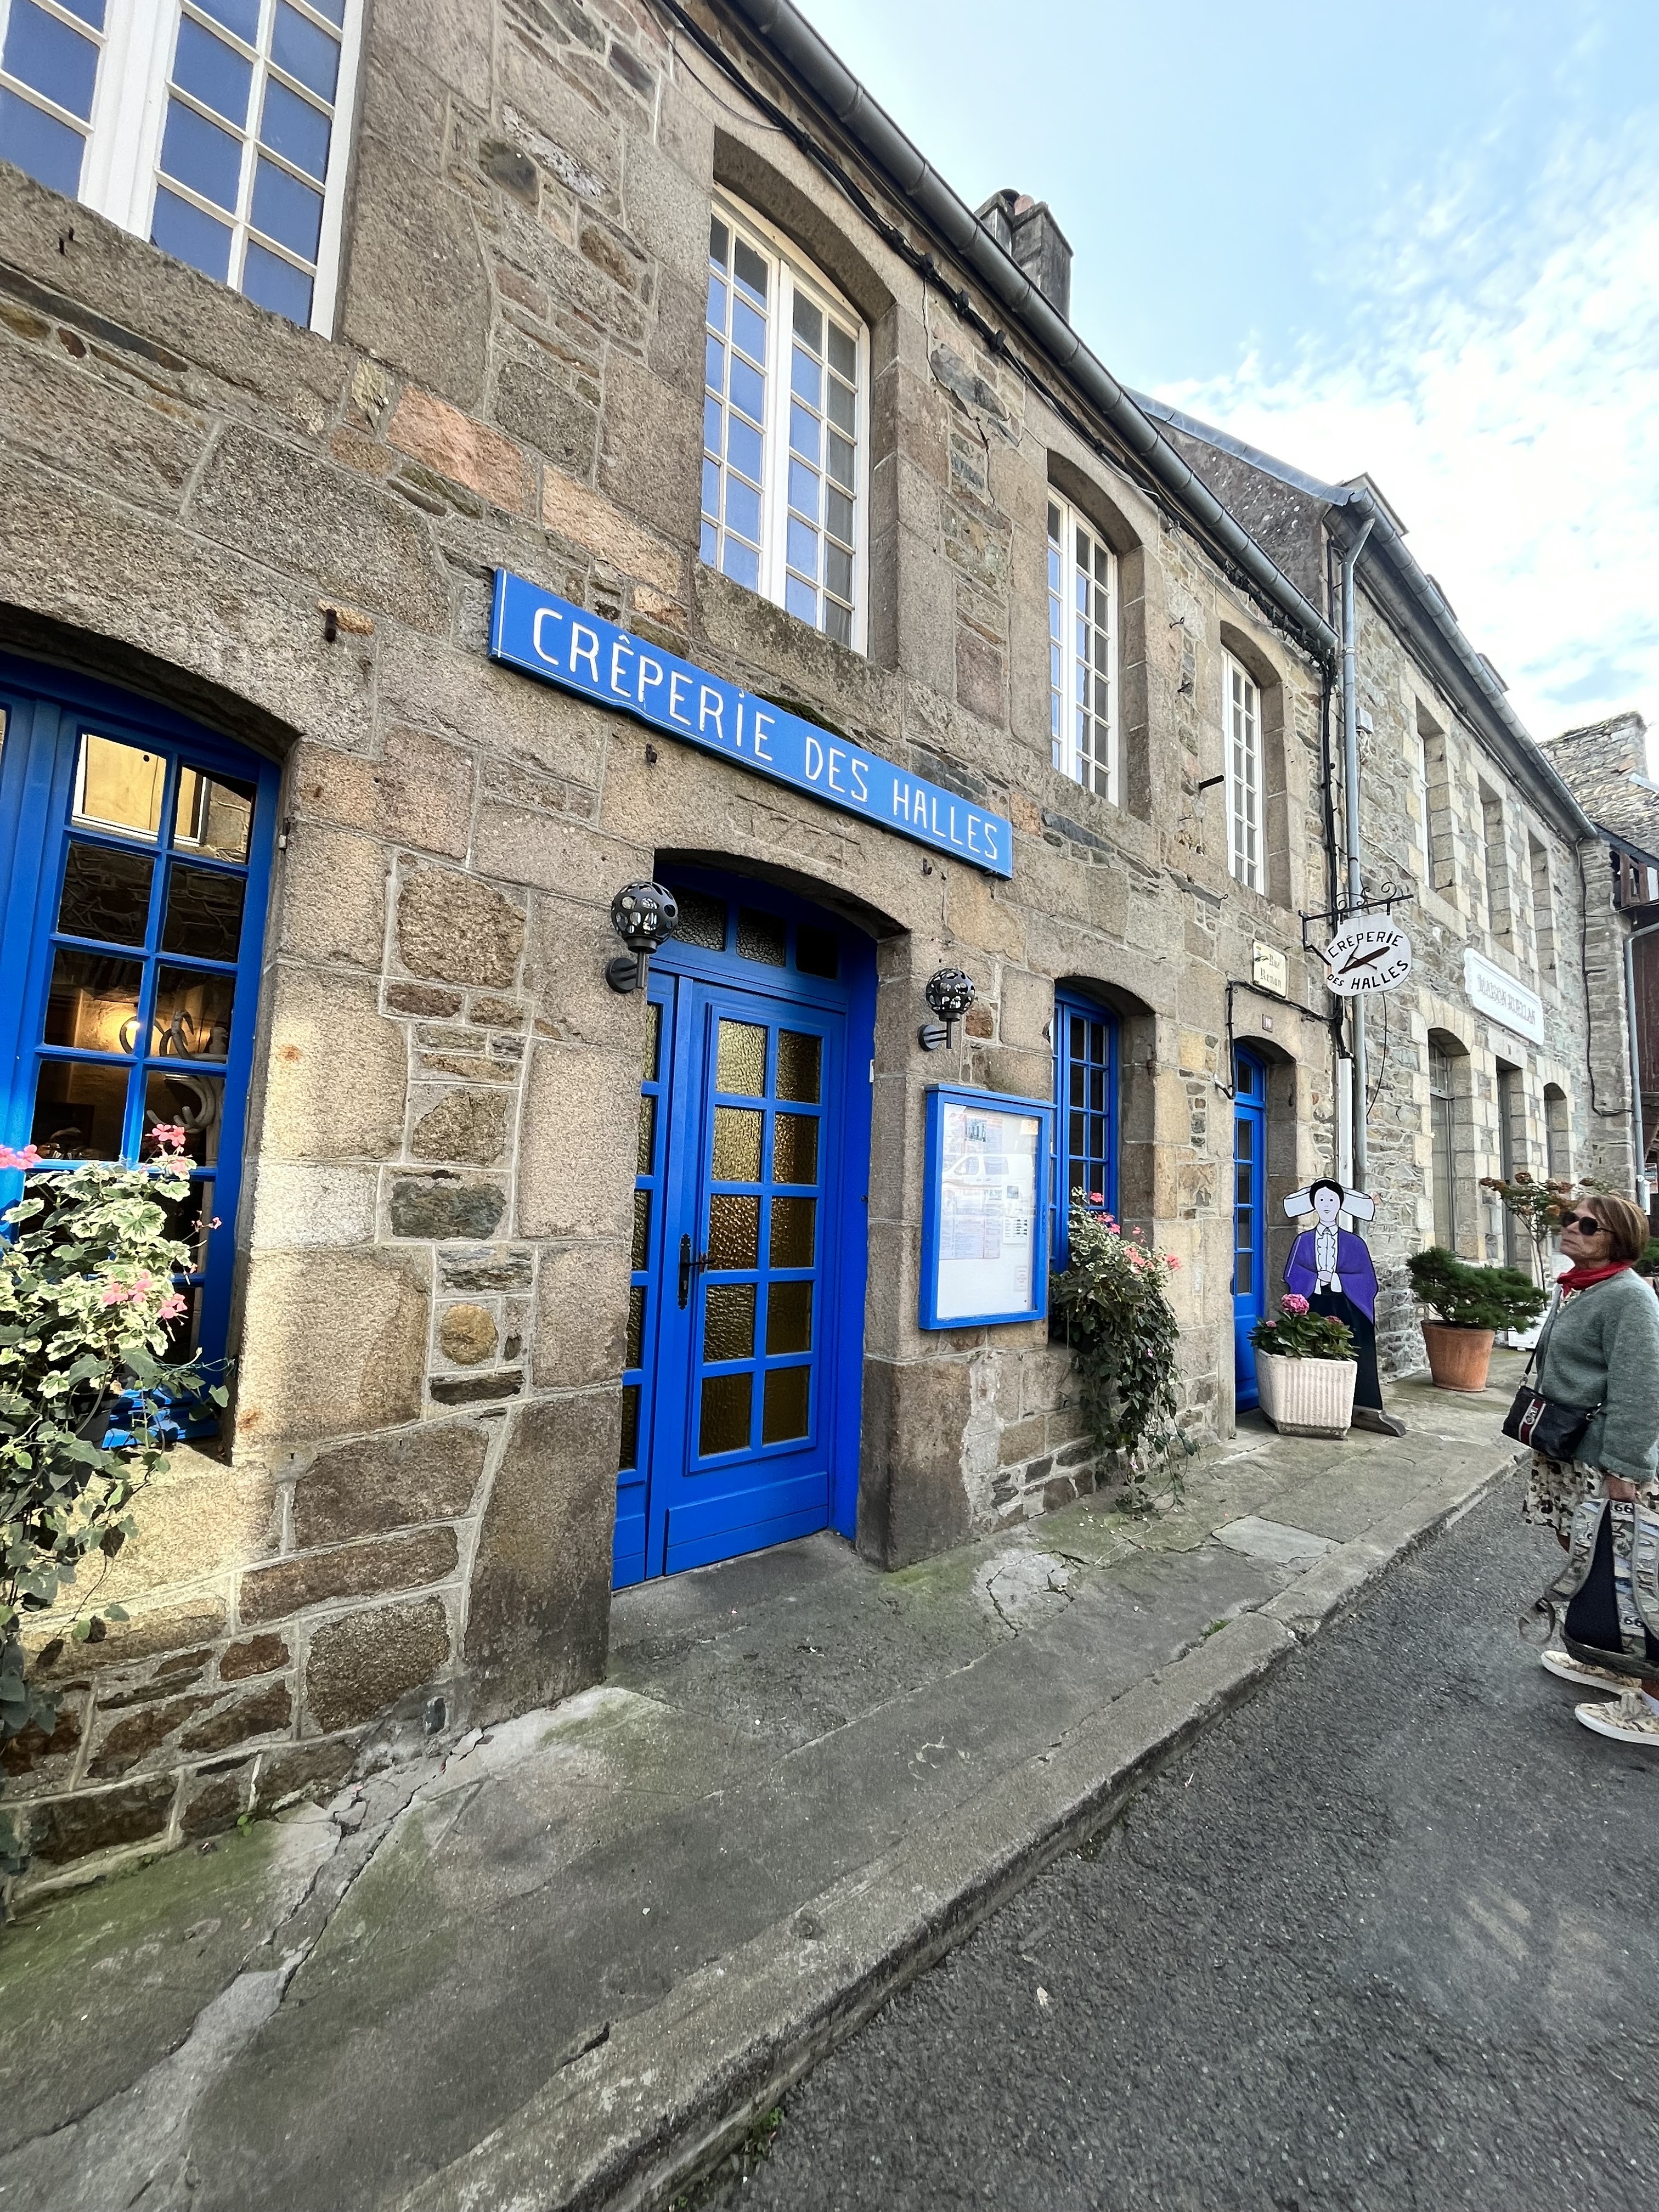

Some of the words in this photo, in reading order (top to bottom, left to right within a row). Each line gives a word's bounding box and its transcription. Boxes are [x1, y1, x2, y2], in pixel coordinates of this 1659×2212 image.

[805, 736, 868, 803] DES
[893, 777, 998, 860] HALLES
[1260, 967, 1282, 988] Renan
[1327, 974, 1345, 986] DES
[1351, 960, 1408, 990] HALLES
